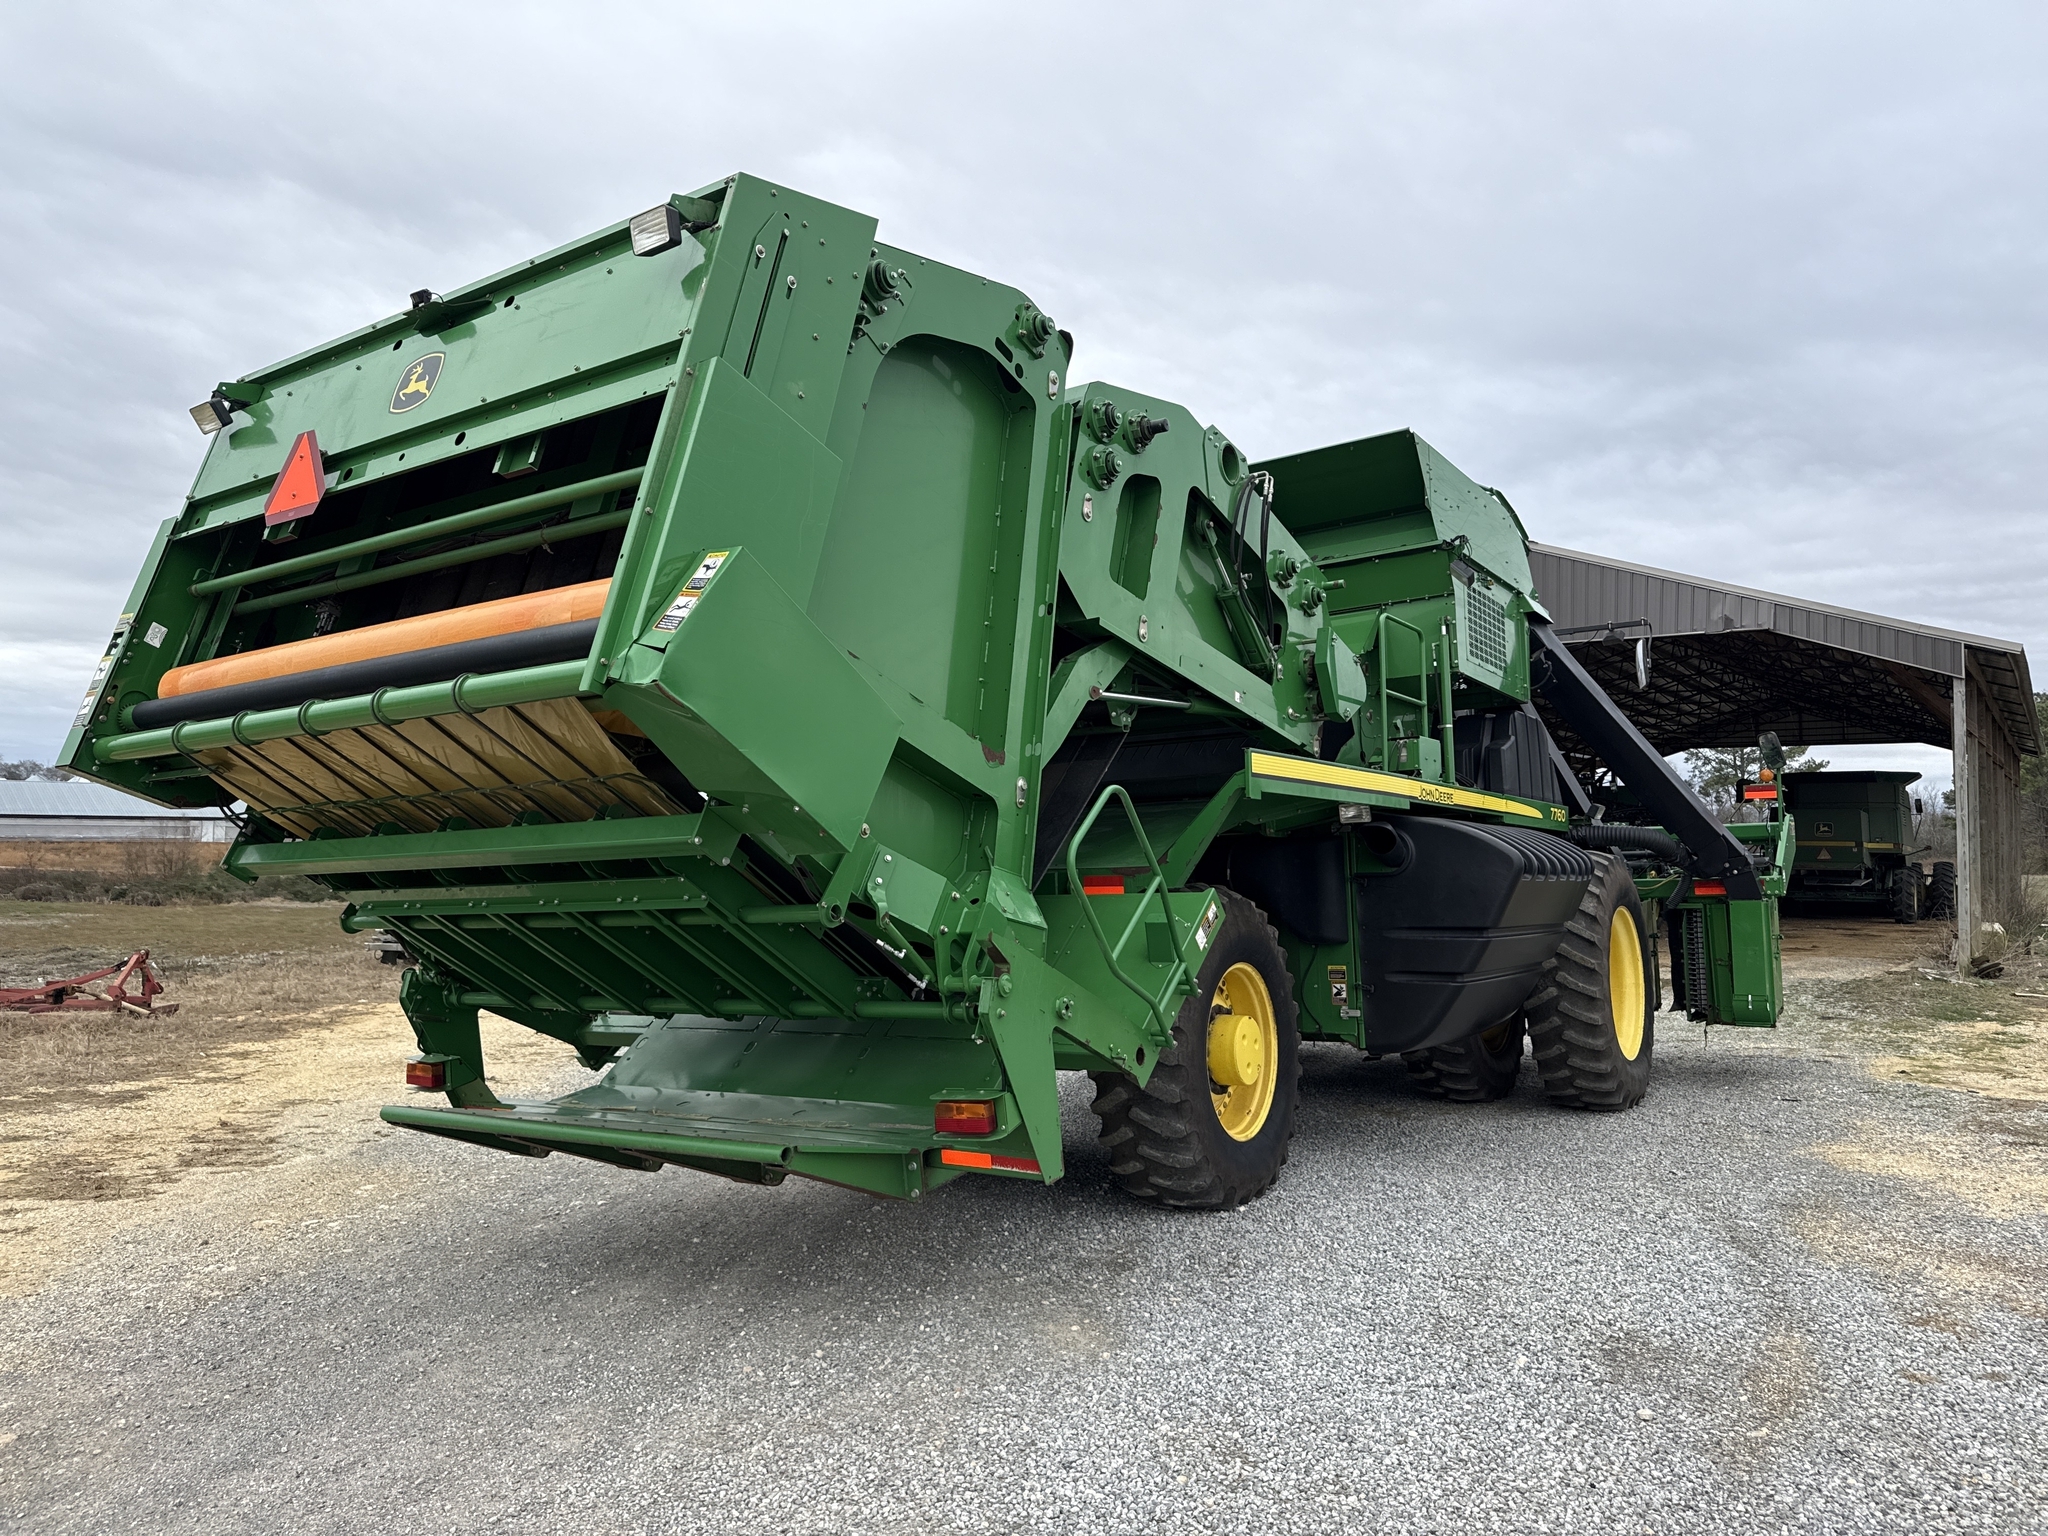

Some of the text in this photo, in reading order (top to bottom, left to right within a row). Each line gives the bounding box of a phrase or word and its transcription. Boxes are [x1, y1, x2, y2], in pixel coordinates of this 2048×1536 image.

[1418, 785, 1454, 804] JOHN DEERE
[1550, 807, 1566, 822] 7760
